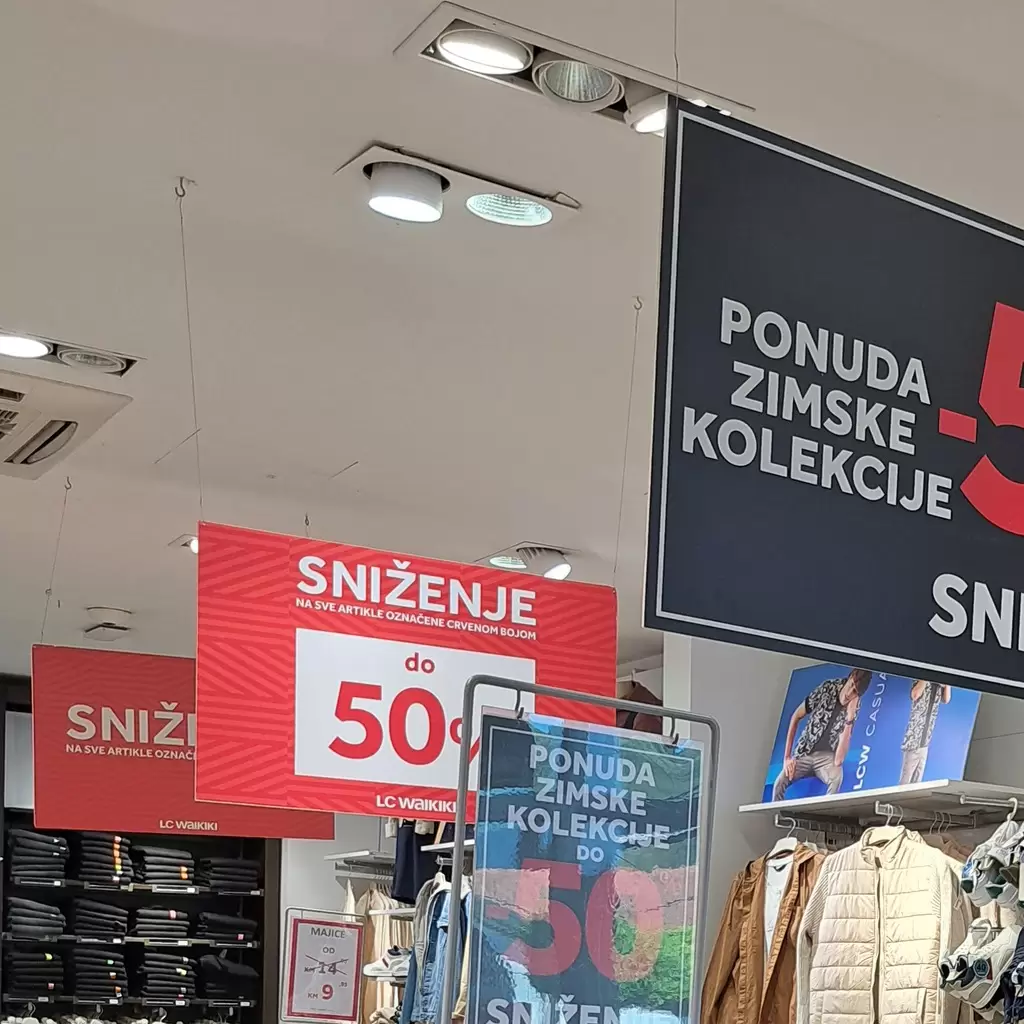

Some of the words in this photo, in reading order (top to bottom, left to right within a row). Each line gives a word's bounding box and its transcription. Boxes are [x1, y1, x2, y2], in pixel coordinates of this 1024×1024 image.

[720, 297, 932, 405] PONUDA
[731, 360, 916, 456] ZIMSKE
[682, 406, 952, 520] KOLEKCIJE
[296, 555, 537, 626] SNIŽENJE
[295, 597, 312, 609] NA
[314, 600, 337, 612] SVE
[338, 603, 384, 619] ARTIKLE
[386, 611, 445, 628] OZNAČENE
[446, 620, 499, 635] CRVENOM
[500, 627, 537, 641] BOJOM
[405, 652, 435, 674] do
[65, 744, 82, 753] NA
[84, 745, 106, 755] SVE
[107, 748, 153, 758] ARTIKLE
[154, 749, 196, 761] OZNAČ
[529, 744, 656, 788] PONUDA
[852, 744, 871, 790] LCW
[376, 795, 396, 808] LC
[535, 776, 647, 816] ZIMSKE
[159, 820, 174, 829] LC
[507, 804, 671, 850] KOLEKCIJE
[576, 845, 605, 863] DO
[310, 927, 346, 939] MAJICE
[322, 946, 336, 954] OD
[318, 961, 337, 975] 14
[321, 984, 334, 1000] 9
